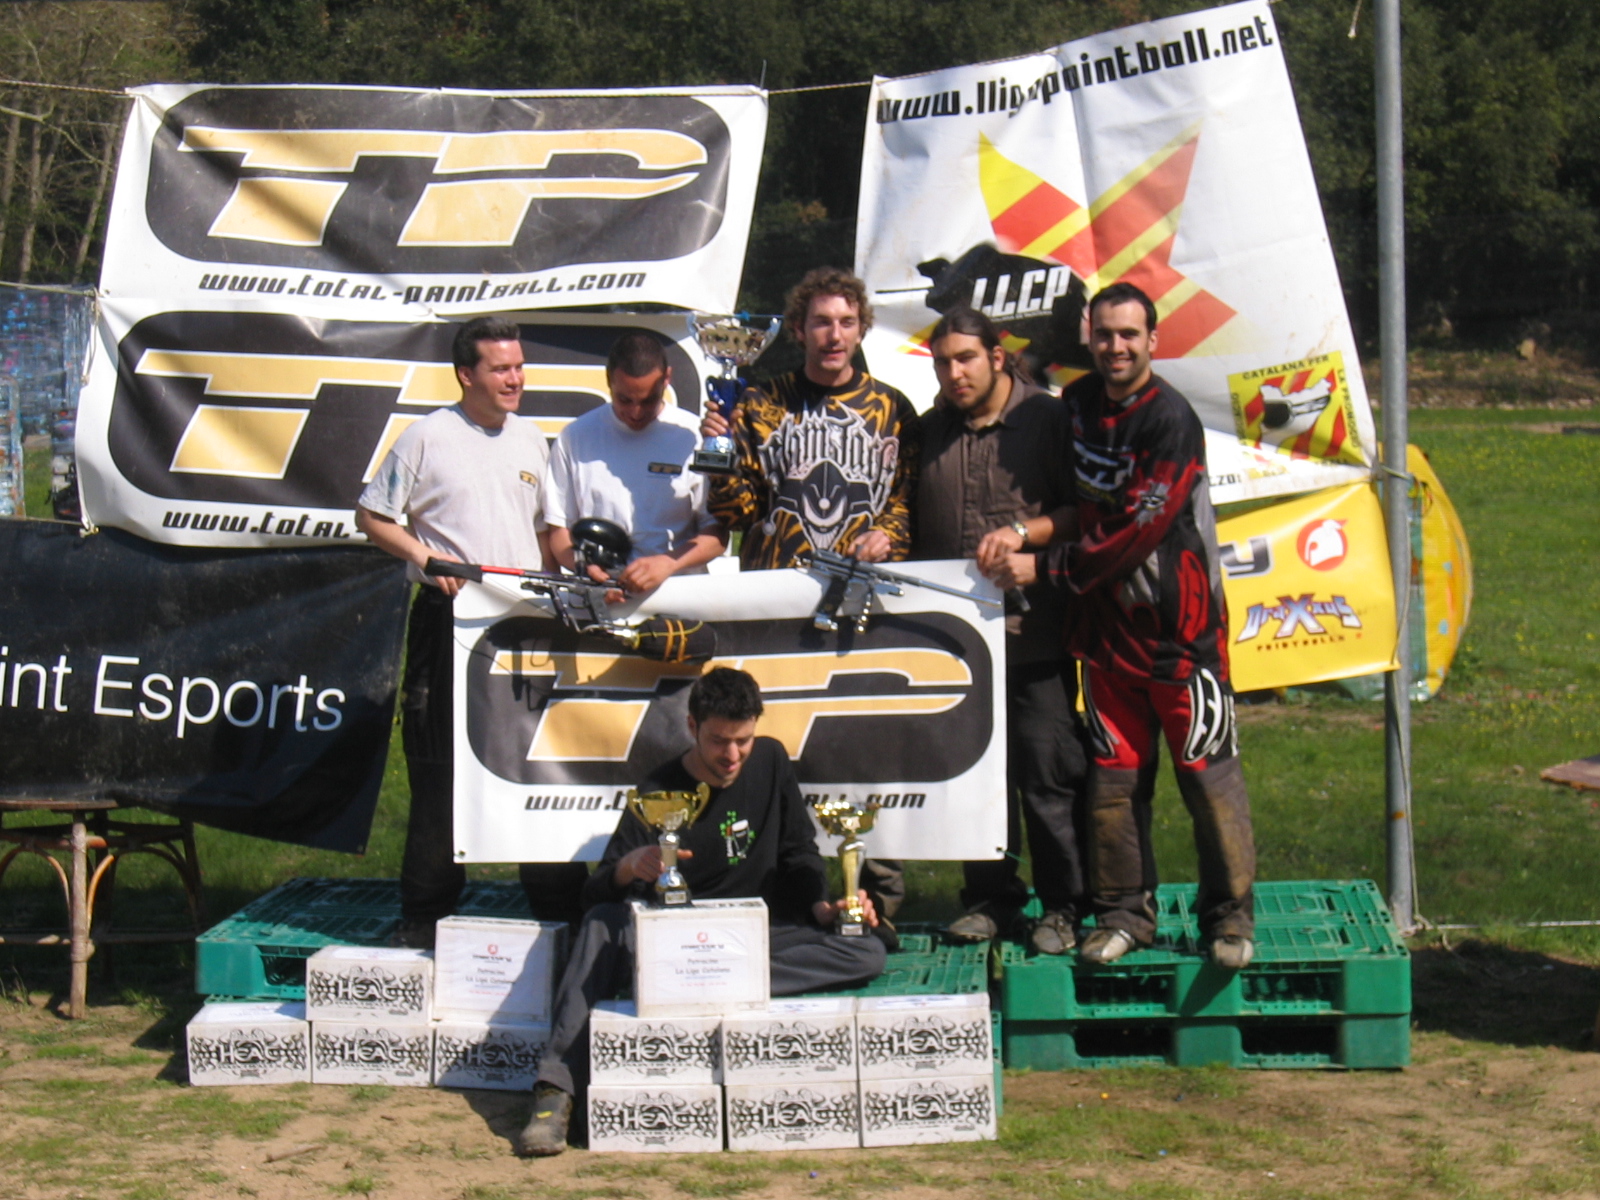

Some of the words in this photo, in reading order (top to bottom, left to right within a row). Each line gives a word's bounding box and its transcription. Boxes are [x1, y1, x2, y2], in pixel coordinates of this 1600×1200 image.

[970, 264, 1072, 318] LLCP
[1242, 360, 1305, 380] CATALANA
[162, 511, 373, 543] www.total-
[0, 646, 73, 712] int
[93, 654, 347, 739] Esports
